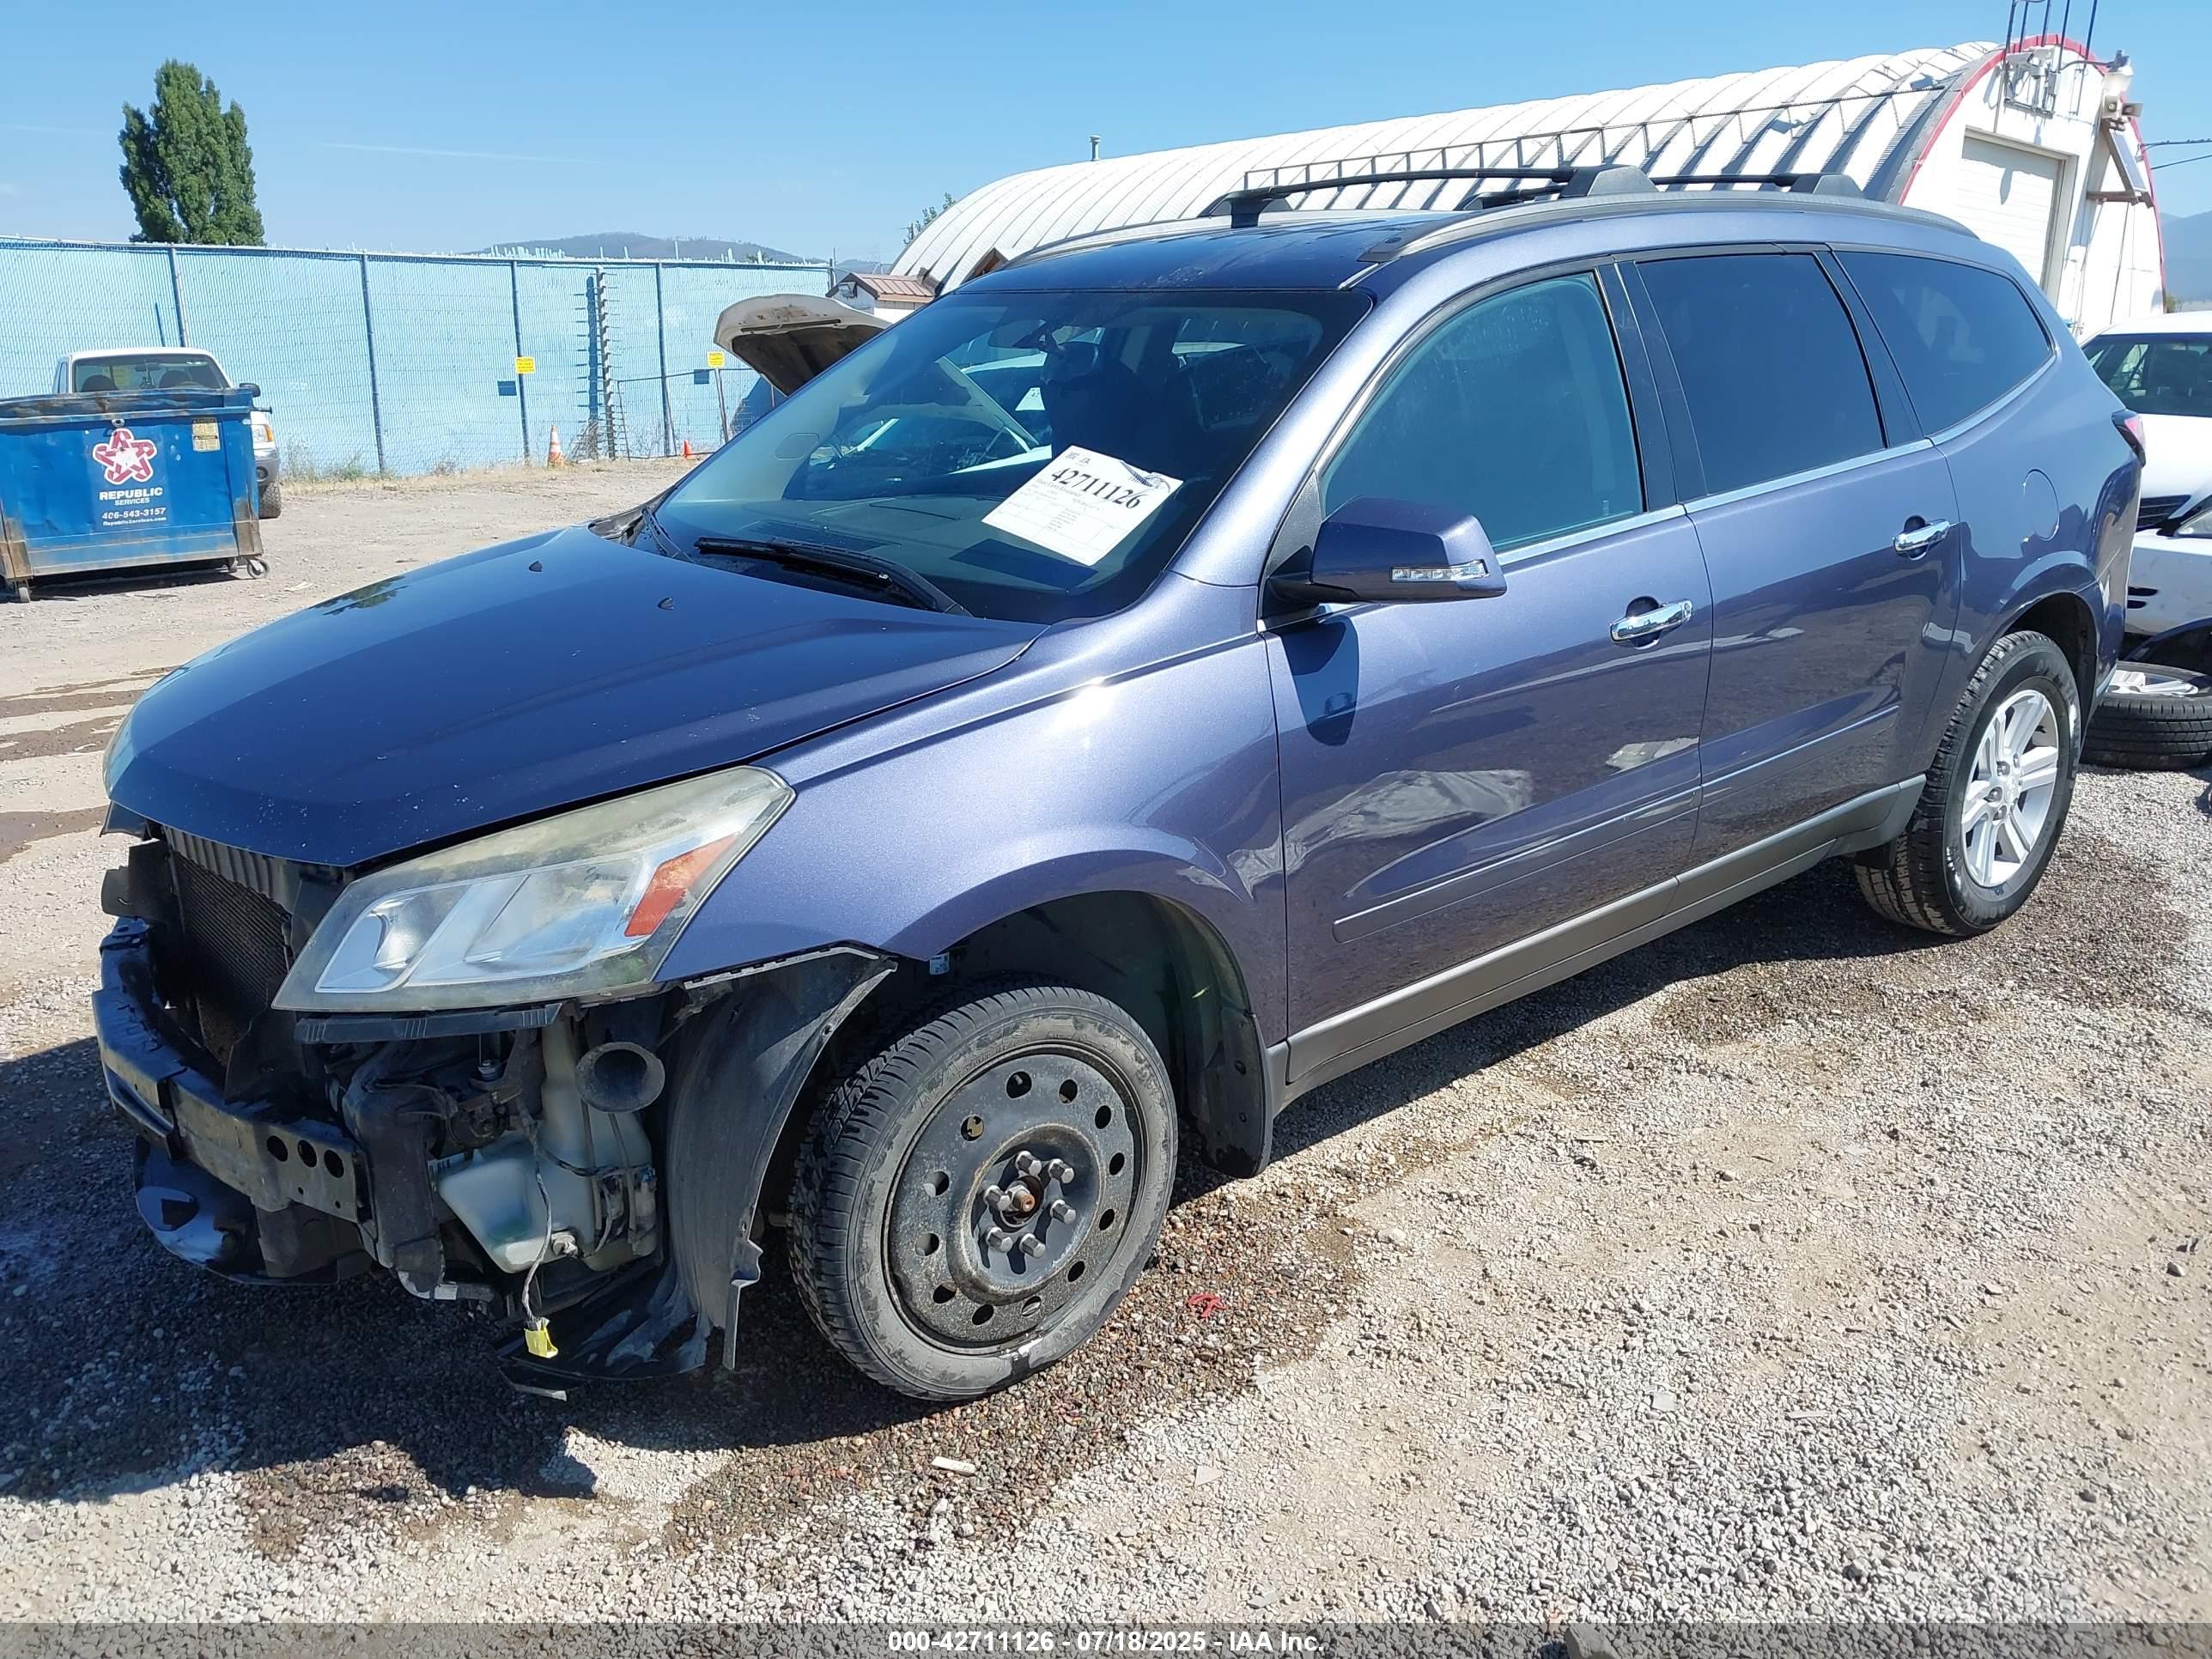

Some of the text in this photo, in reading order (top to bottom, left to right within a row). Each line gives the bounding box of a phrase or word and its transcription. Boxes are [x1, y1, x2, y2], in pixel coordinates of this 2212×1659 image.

[100, 488, 163, 501] REPUBLIC
[1051, 468, 1148, 509] 42711126
[114, 497, 150, 506] SERVICES
